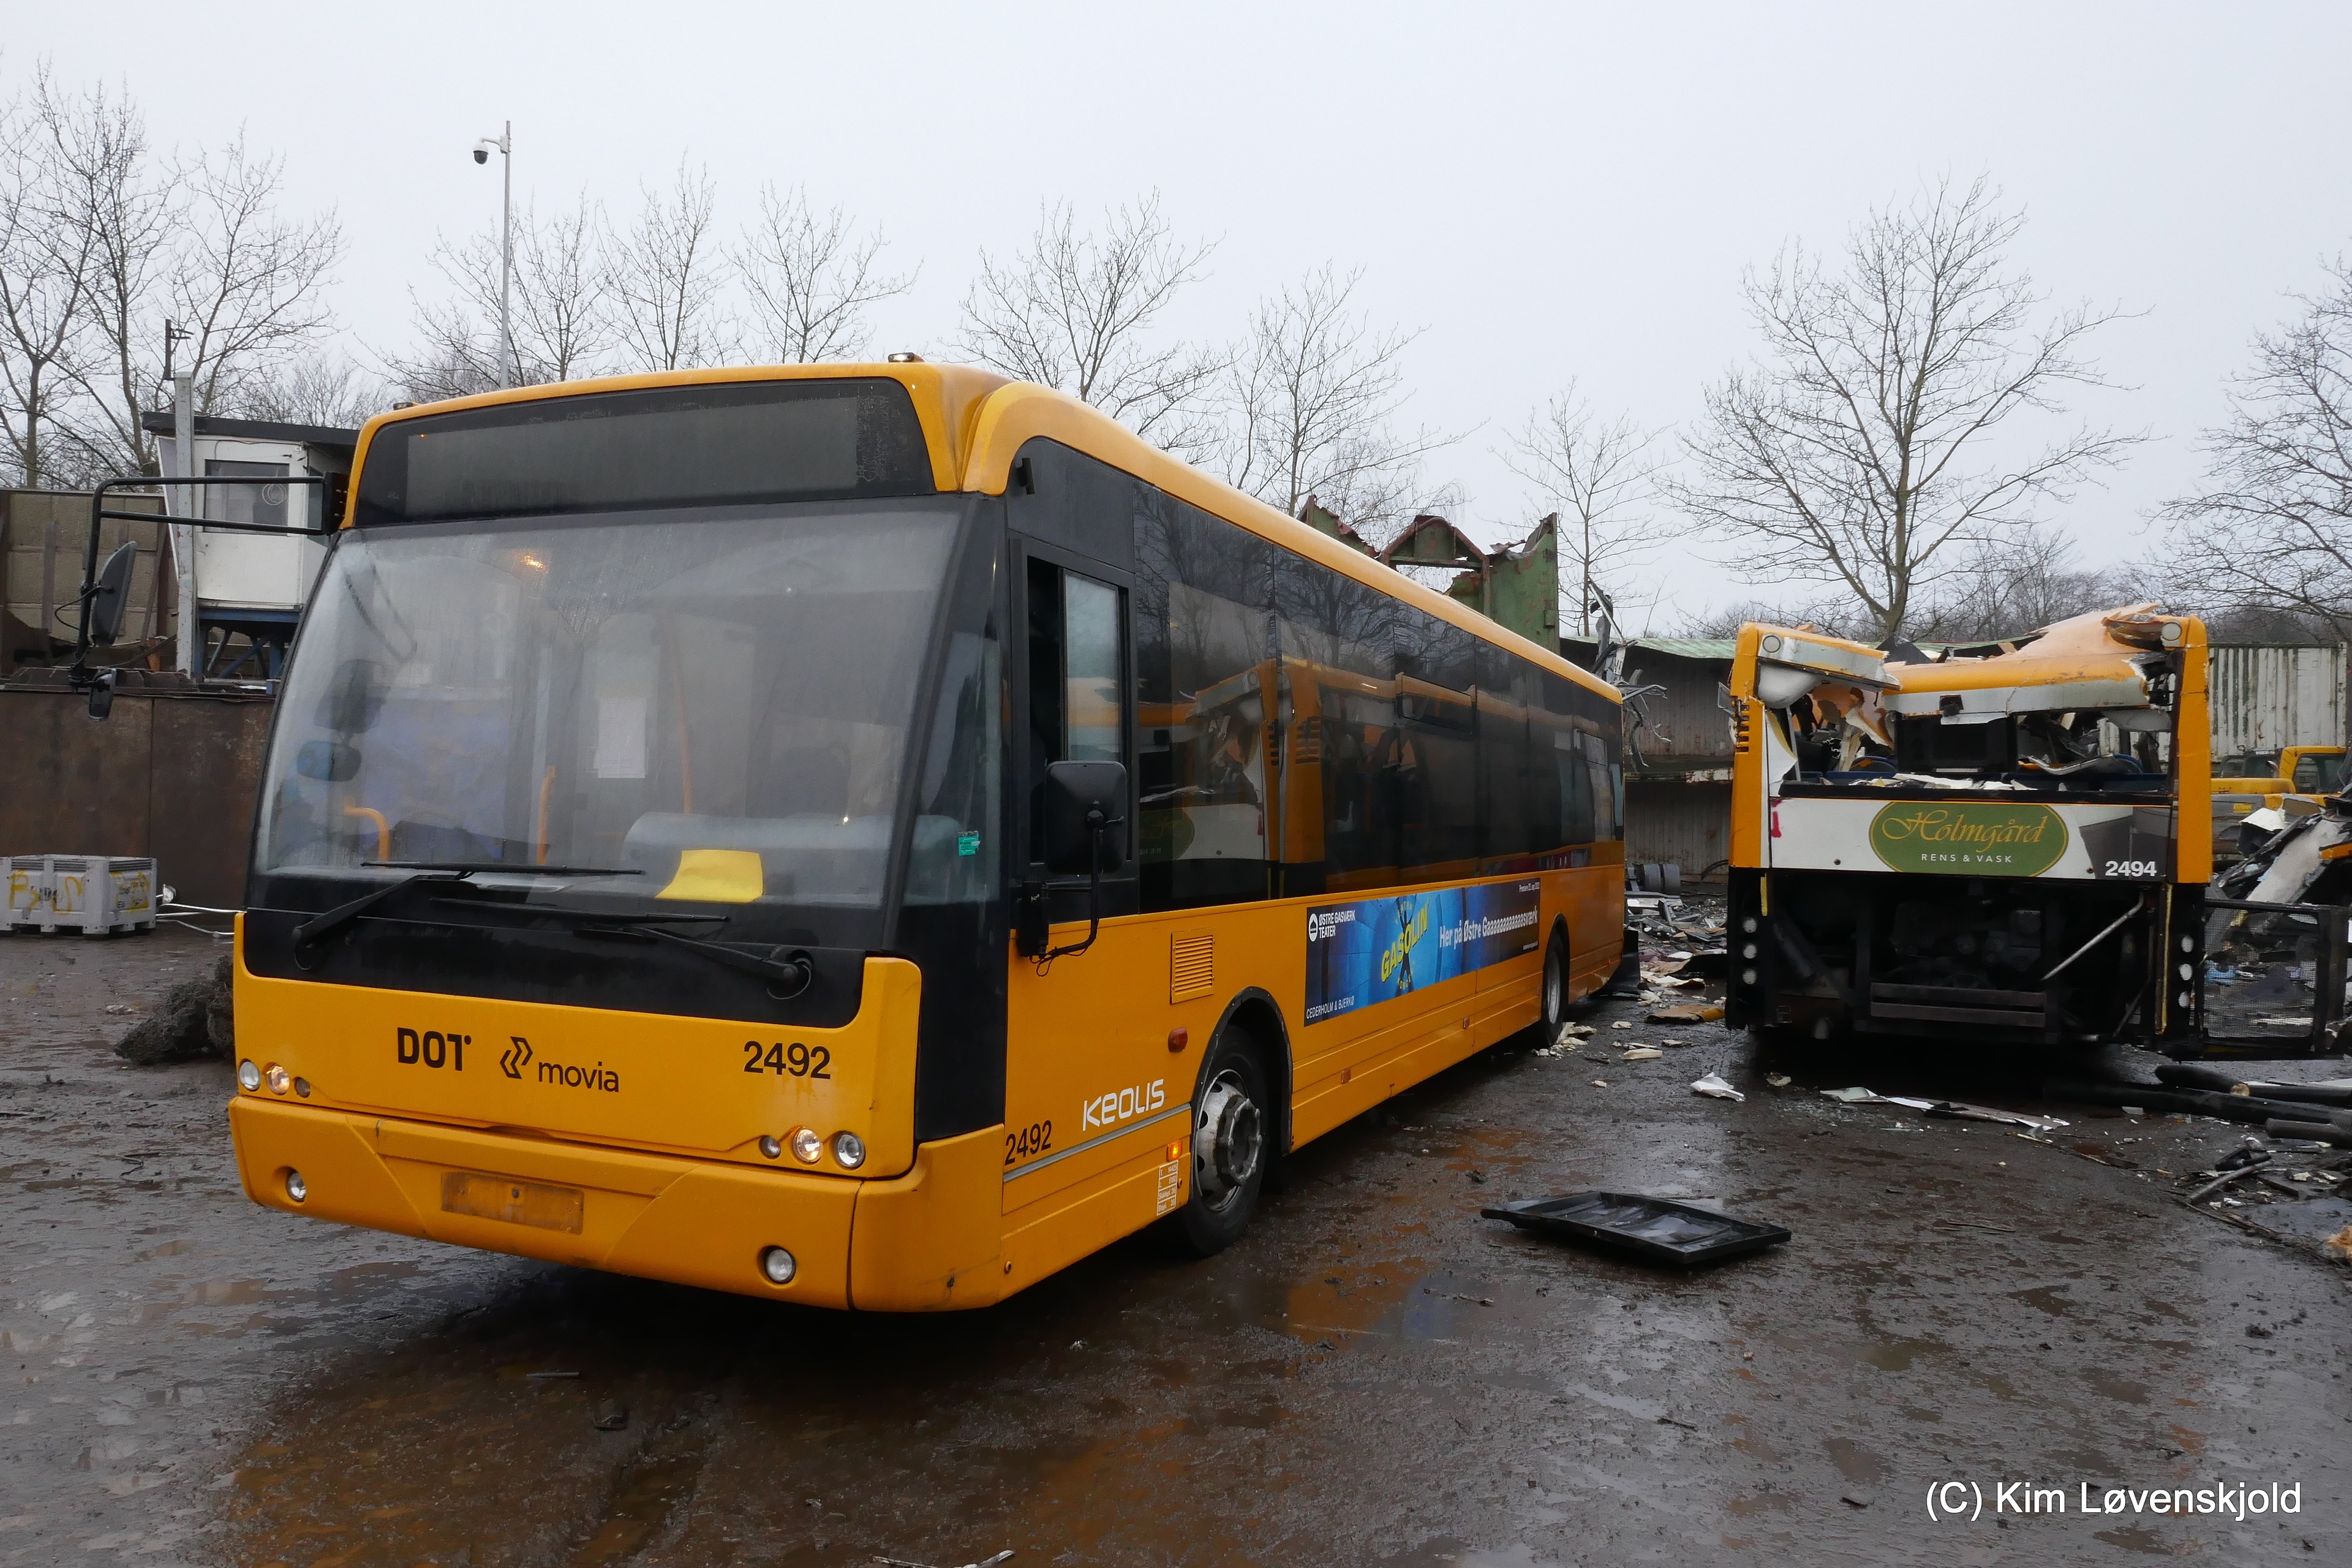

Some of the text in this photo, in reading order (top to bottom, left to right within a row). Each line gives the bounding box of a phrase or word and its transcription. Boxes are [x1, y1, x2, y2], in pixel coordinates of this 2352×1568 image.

[1882, 810, 2048, 853] Holmgård
[1921, 853, 1956, 862] RENS
[1977, 855, 2012, 864] VASK
[2105, 861, 2157, 877] 2494
[1319, 910, 1355, 926] ØSTRE GASVÆRK
[1319, 925, 1336, 938] TEATER
[1439, 925, 1452, 948] Her
[1454, 919, 1462, 949] på
[1463, 918, 1481, 942] Østre
[1306, 995, 1354, 1019] CEDERHOLM & BJERKØ
[397, 1027, 470, 1071] DOT
[744, 1041, 831, 1079] 2492
[538, 1060, 619, 1093] movia
[1082, 1079, 1164, 1131] KEOLIS
[1005, 1120, 1052, 1166] 2492
